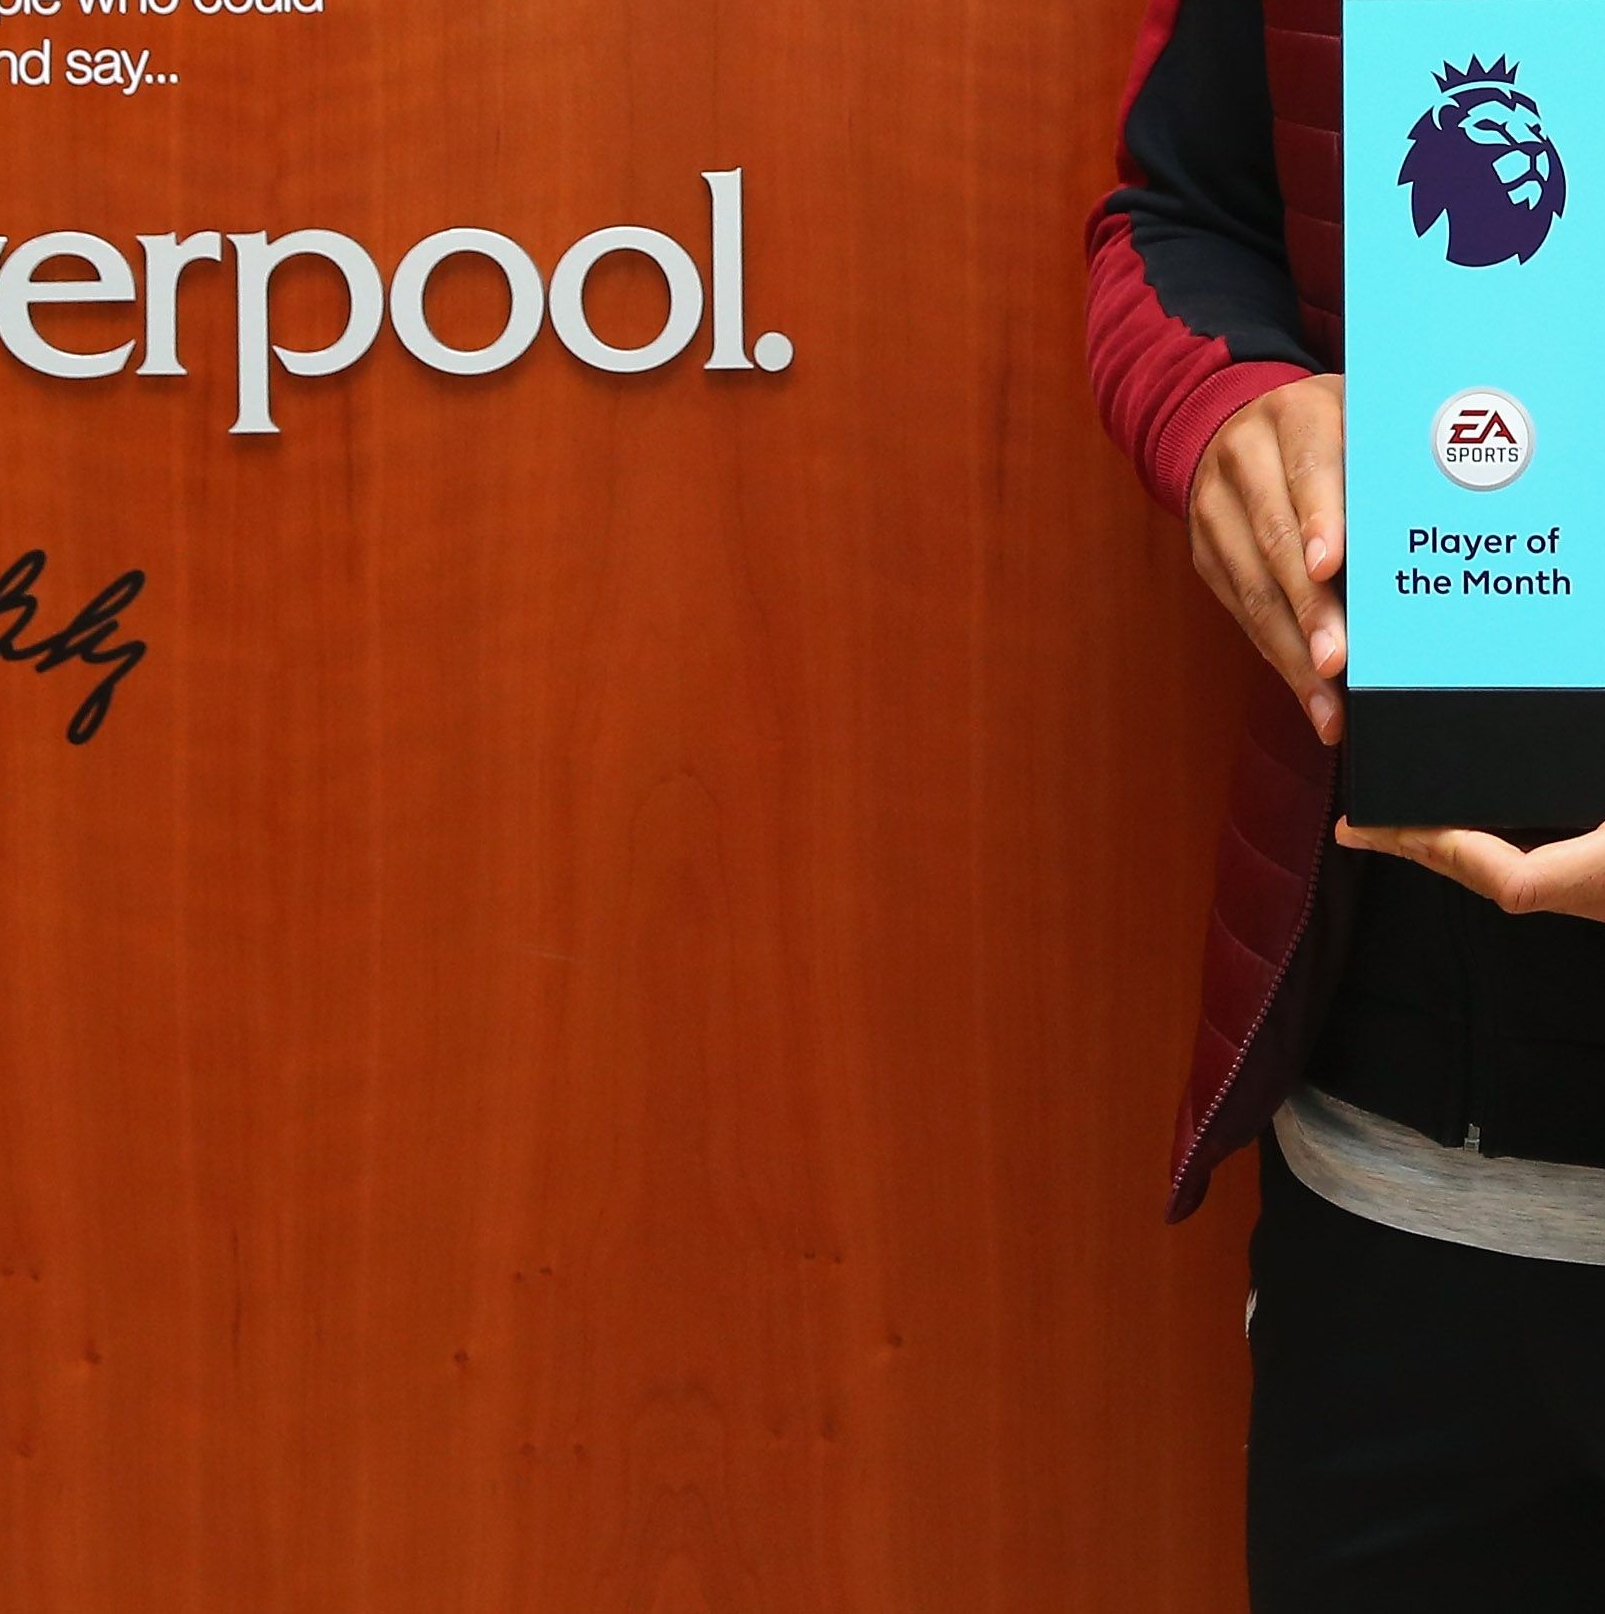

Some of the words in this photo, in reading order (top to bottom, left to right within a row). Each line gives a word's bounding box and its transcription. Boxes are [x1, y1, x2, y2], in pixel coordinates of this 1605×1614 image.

[67, 50, 179, 96] say...
[1448, 410, 1517, 444] EA
[1446, 447, 1519, 463] SPORTS
[1409, 527, 1517, 560] Player
[1526, 527, 1560, 554] of
[1396, 568, 1452, 594] the
[1463, 568, 1571, 595] Month
